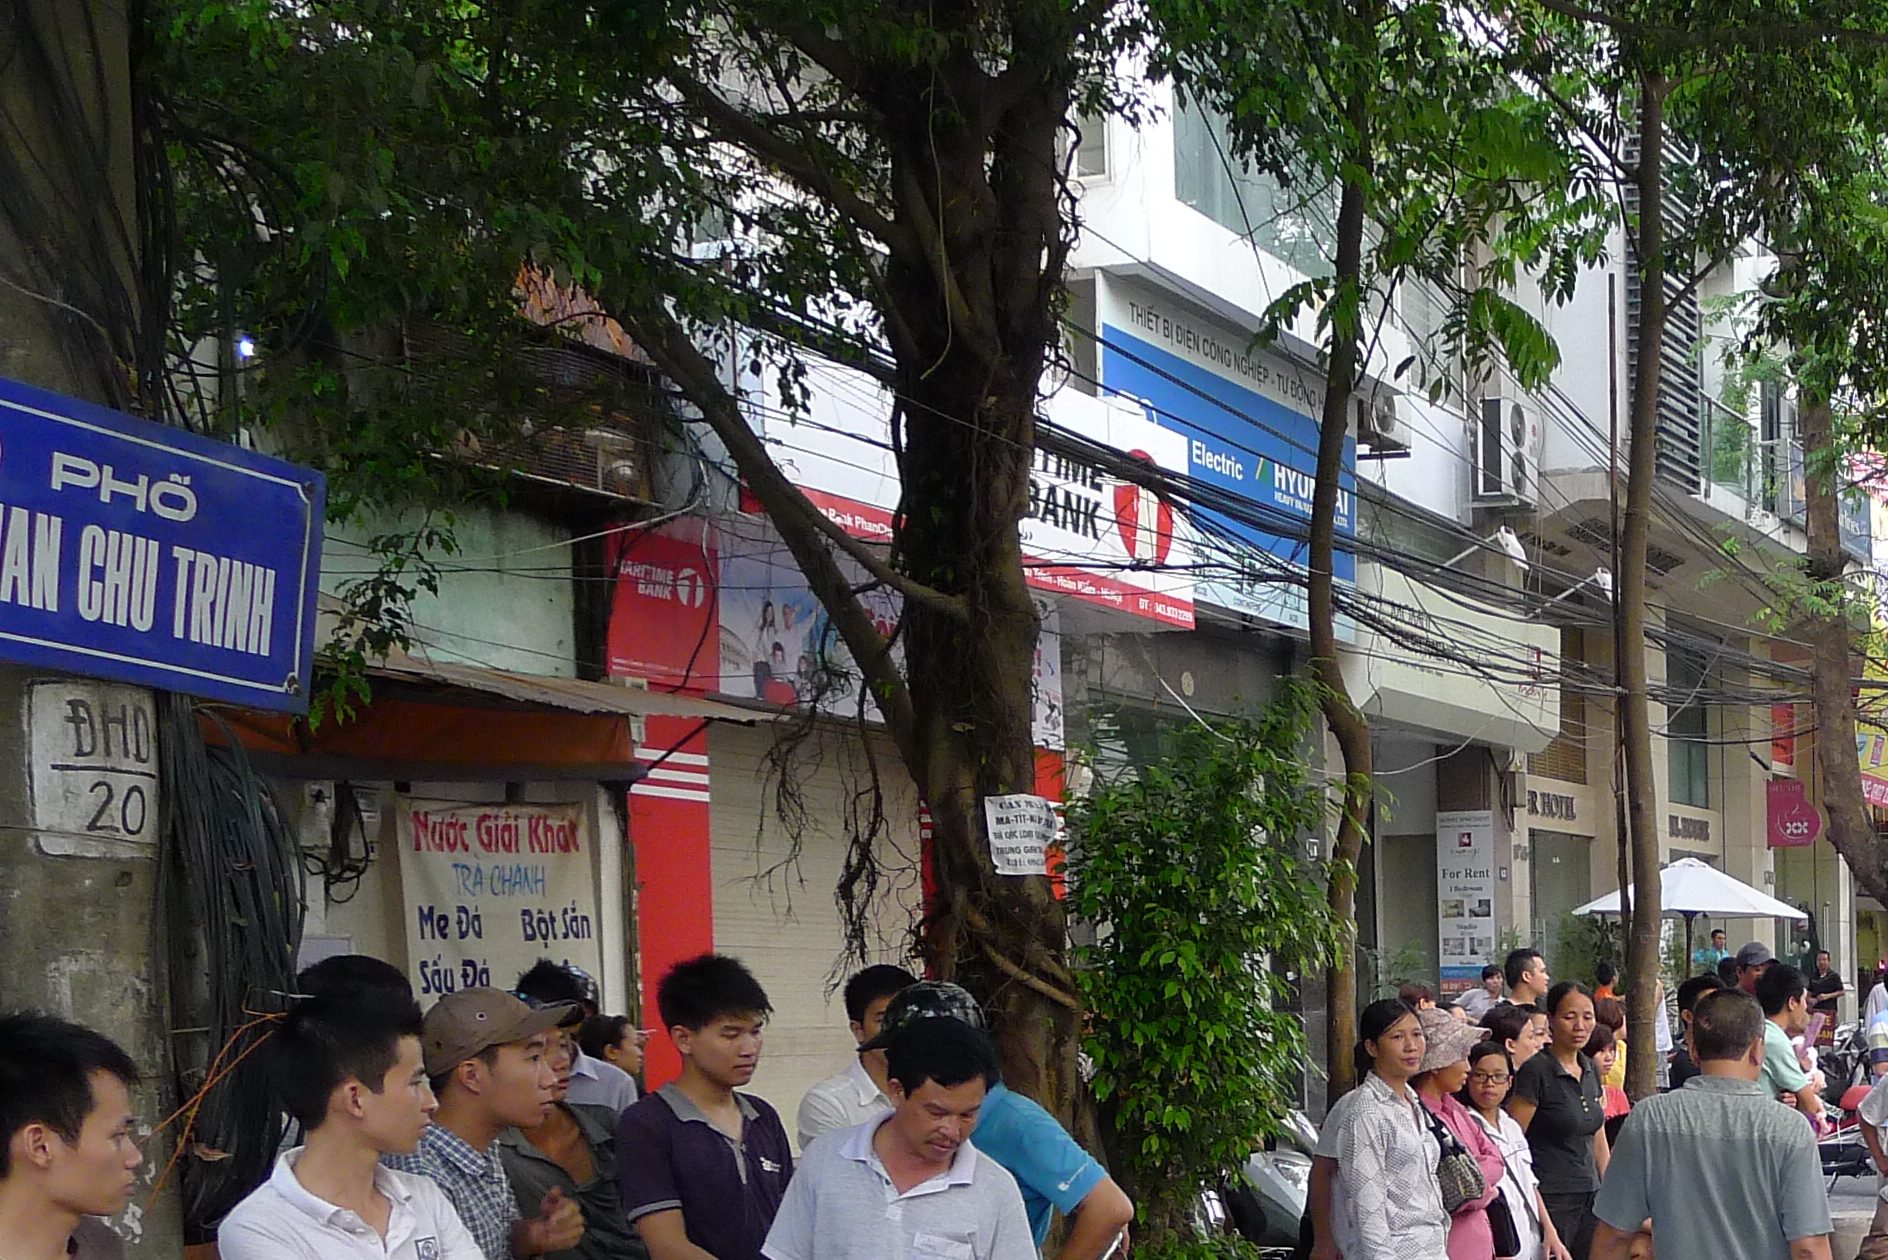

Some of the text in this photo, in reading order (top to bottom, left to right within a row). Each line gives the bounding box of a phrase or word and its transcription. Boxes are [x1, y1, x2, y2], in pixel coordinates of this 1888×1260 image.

[1129, 302, 1160, 333] THIẾT
[1163, 318, 1174, 346] BỊ
[1175, 326, 1200, 354] ĐIỆN
[1234, 353, 1269, 387] NGHIỆP
[1192, 439, 1349, 516] Electric HYUAI
[1028, 478, 1101, 541] BANK
[0, 502, 277, 657] AN CHU TRINH
[637, 579, 673, 601] BANK
[86, 780, 146, 836] 20
[411, 810, 580, 854] Nước Giải Khát
[452, 853, 547, 898] TRÀ CHANH
[1442, 867, 1490, 880] For Rent
[418, 905, 449, 940] Me
[455, 905, 483, 940] Đá
[521, 908, 558, 949] Bột
[419, 953, 491, 994] Sấu Đá
